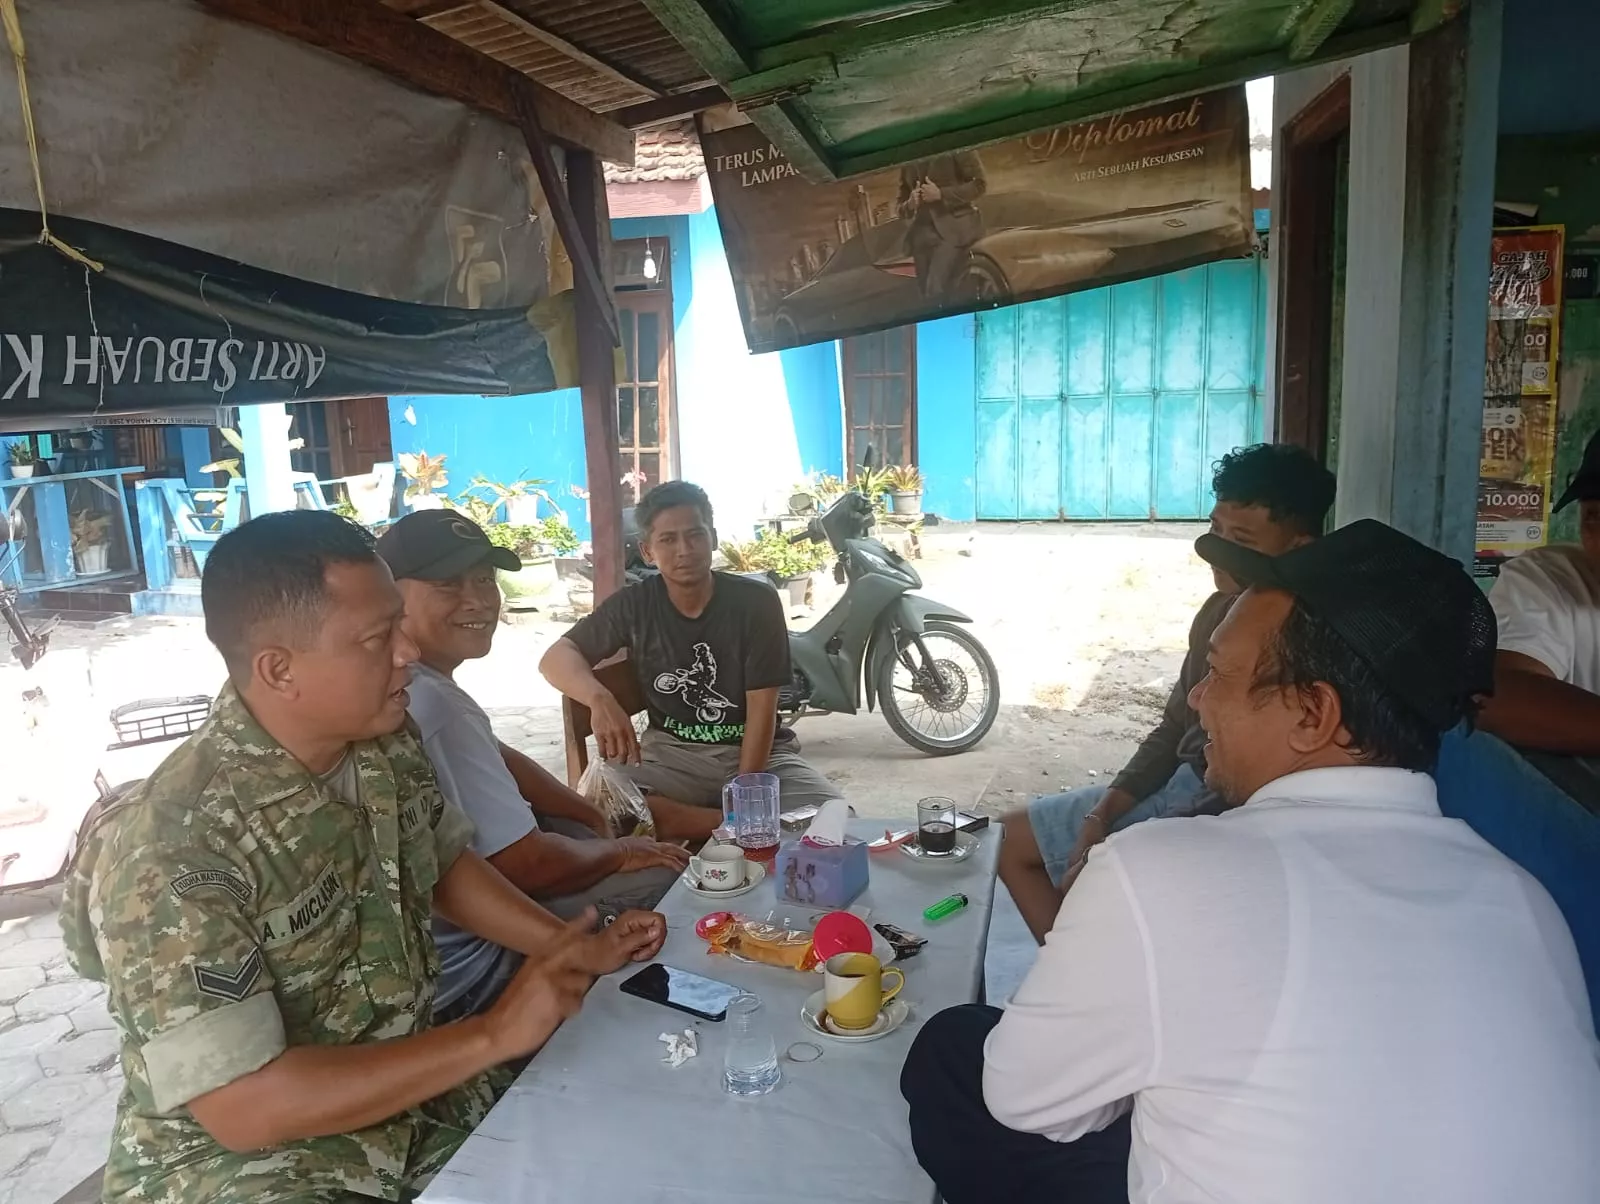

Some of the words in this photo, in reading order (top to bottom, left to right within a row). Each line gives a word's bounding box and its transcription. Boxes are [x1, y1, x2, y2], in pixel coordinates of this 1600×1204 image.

[1027, 97, 1204, 164] Diplomat
[713, 148, 764, 172] TERUS
[768, 143, 785, 161] M
[1072, 171, 1096, 183] ARTI
[1098, 161, 1140, 179] SEBUAH
[1141, 146, 1204, 169] KESUKSESAN
[1499, 251, 1548, 262] GAJAH
[0, 334, 44, 400] K
[62, 335, 245, 393] SEBUAH
[248, 340, 327, 390] ARTI
